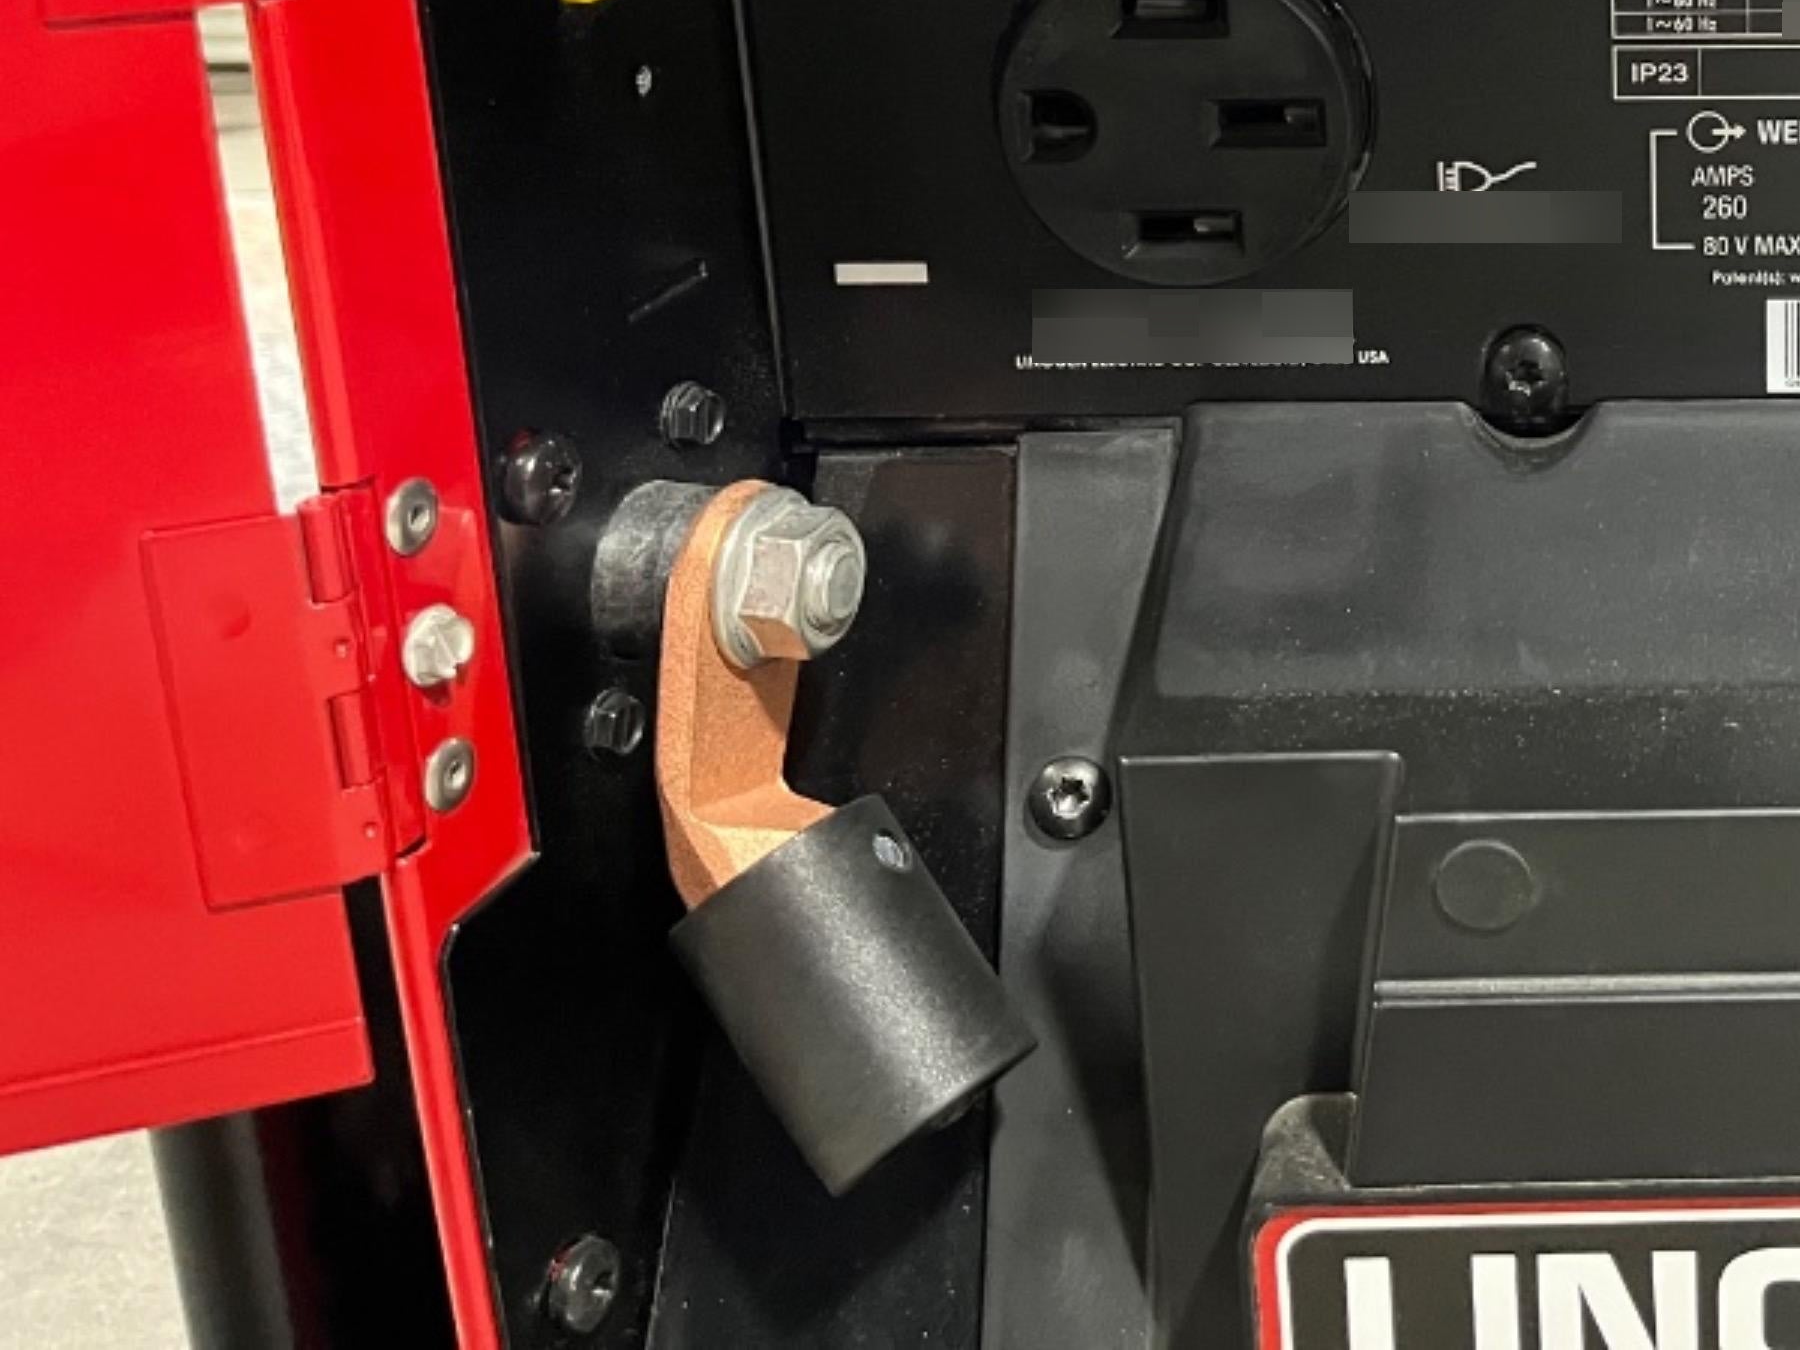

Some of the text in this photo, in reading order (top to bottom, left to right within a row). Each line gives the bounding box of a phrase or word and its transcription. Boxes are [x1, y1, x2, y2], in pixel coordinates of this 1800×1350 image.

[1630, 61, 1690, 84] IP23
[1692, 165, 1755, 187] AMPS
[1702, 195, 1748, 220] 260
[1703, 236, 1729, 256] 80
[1734, 236, 1750, 256] V
[1357, 349, 1391, 364] USA
